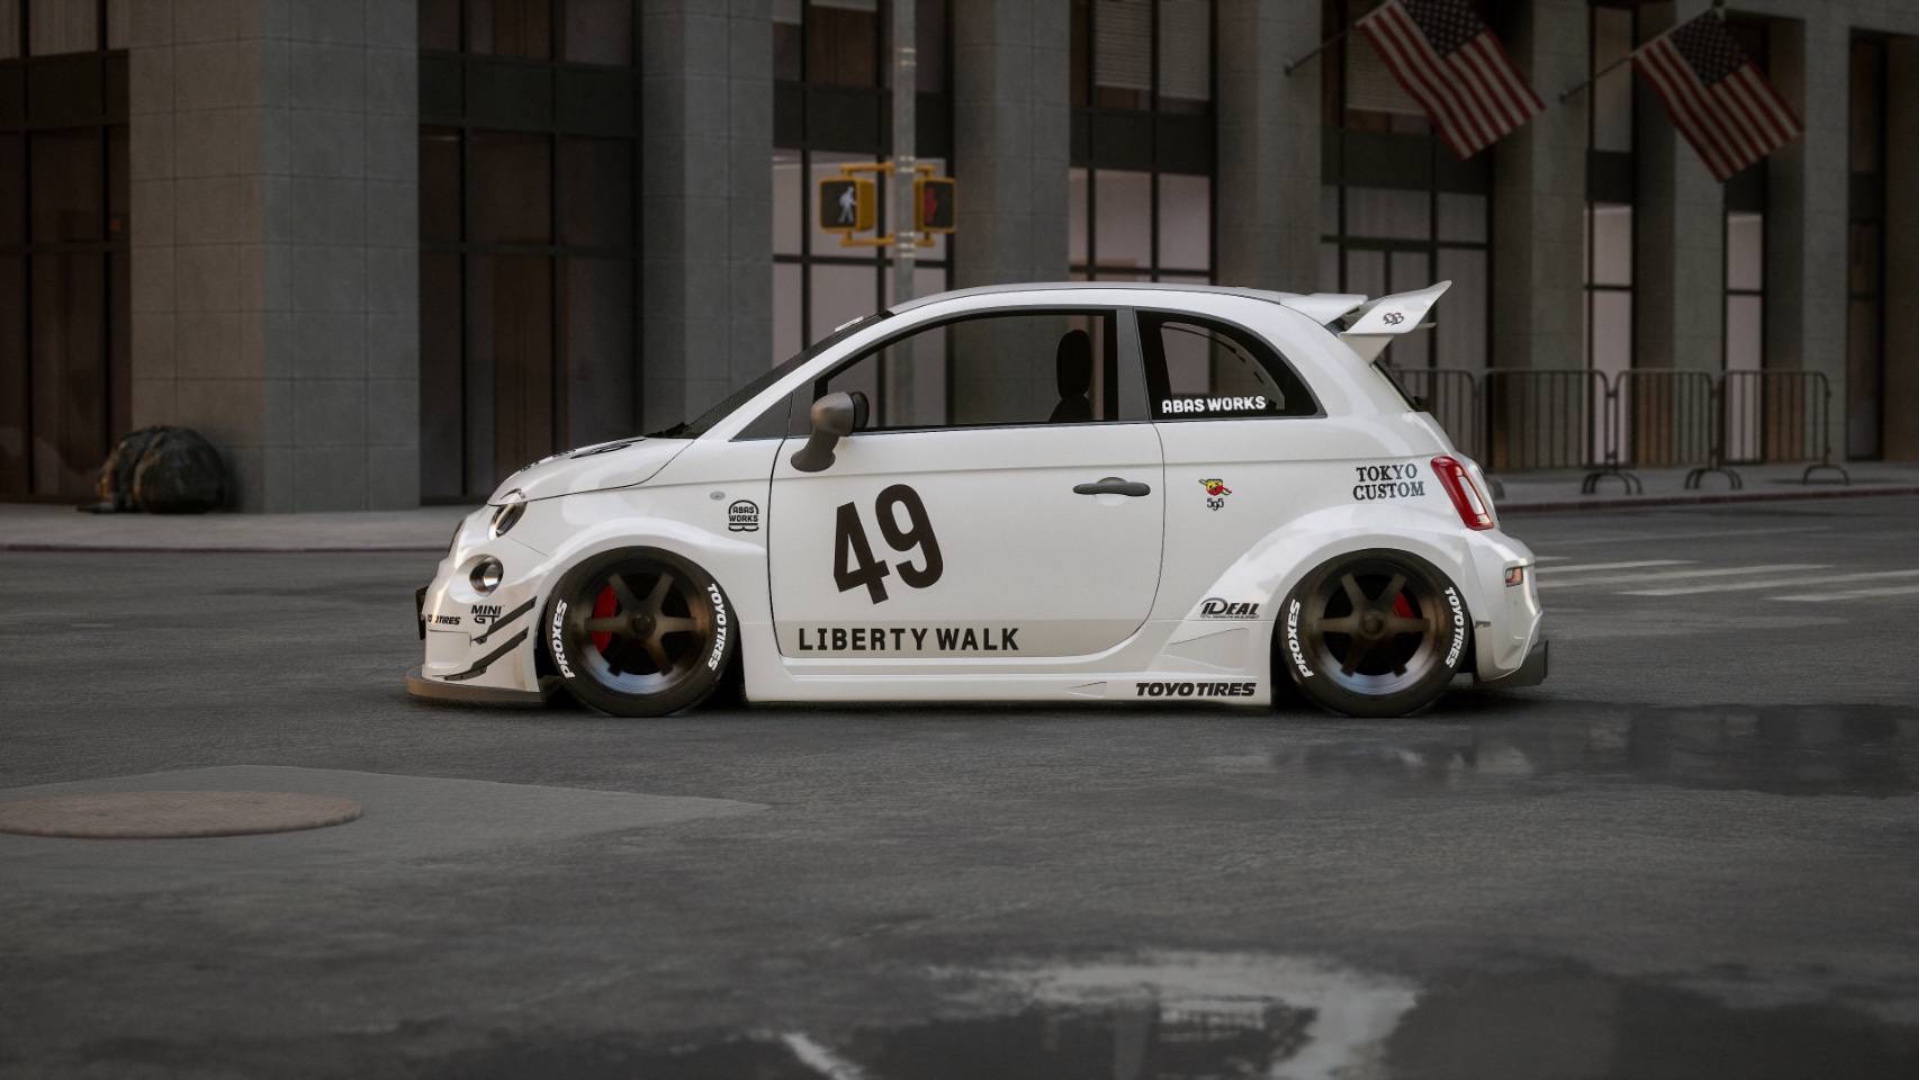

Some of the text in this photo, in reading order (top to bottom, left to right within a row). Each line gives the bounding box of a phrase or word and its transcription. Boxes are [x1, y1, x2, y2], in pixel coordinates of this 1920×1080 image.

[1162, 396, 1266, 413] ABAS WORKS
[1356, 463, 1418, 482] TOKYO
[1353, 481, 1425, 501] CUSTOM
[729, 514, 758, 522] WORKS
[732, 506, 755, 514] ABAS
[833, 483, 944, 605] 49
[471, 604, 502, 615] MINI
[1200, 597, 1260, 615] IDEAL
[707, 583, 727, 671] TOYO TIRES
[1445, 586, 1464, 668] TOYO TIRES
[552, 599, 575, 679] PROXES
[799, 627, 1019, 651] LIBERTY WALK
[1287, 599, 1315, 678] PROXES
[1136, 682, 1257, 696] TOYO TIRES
